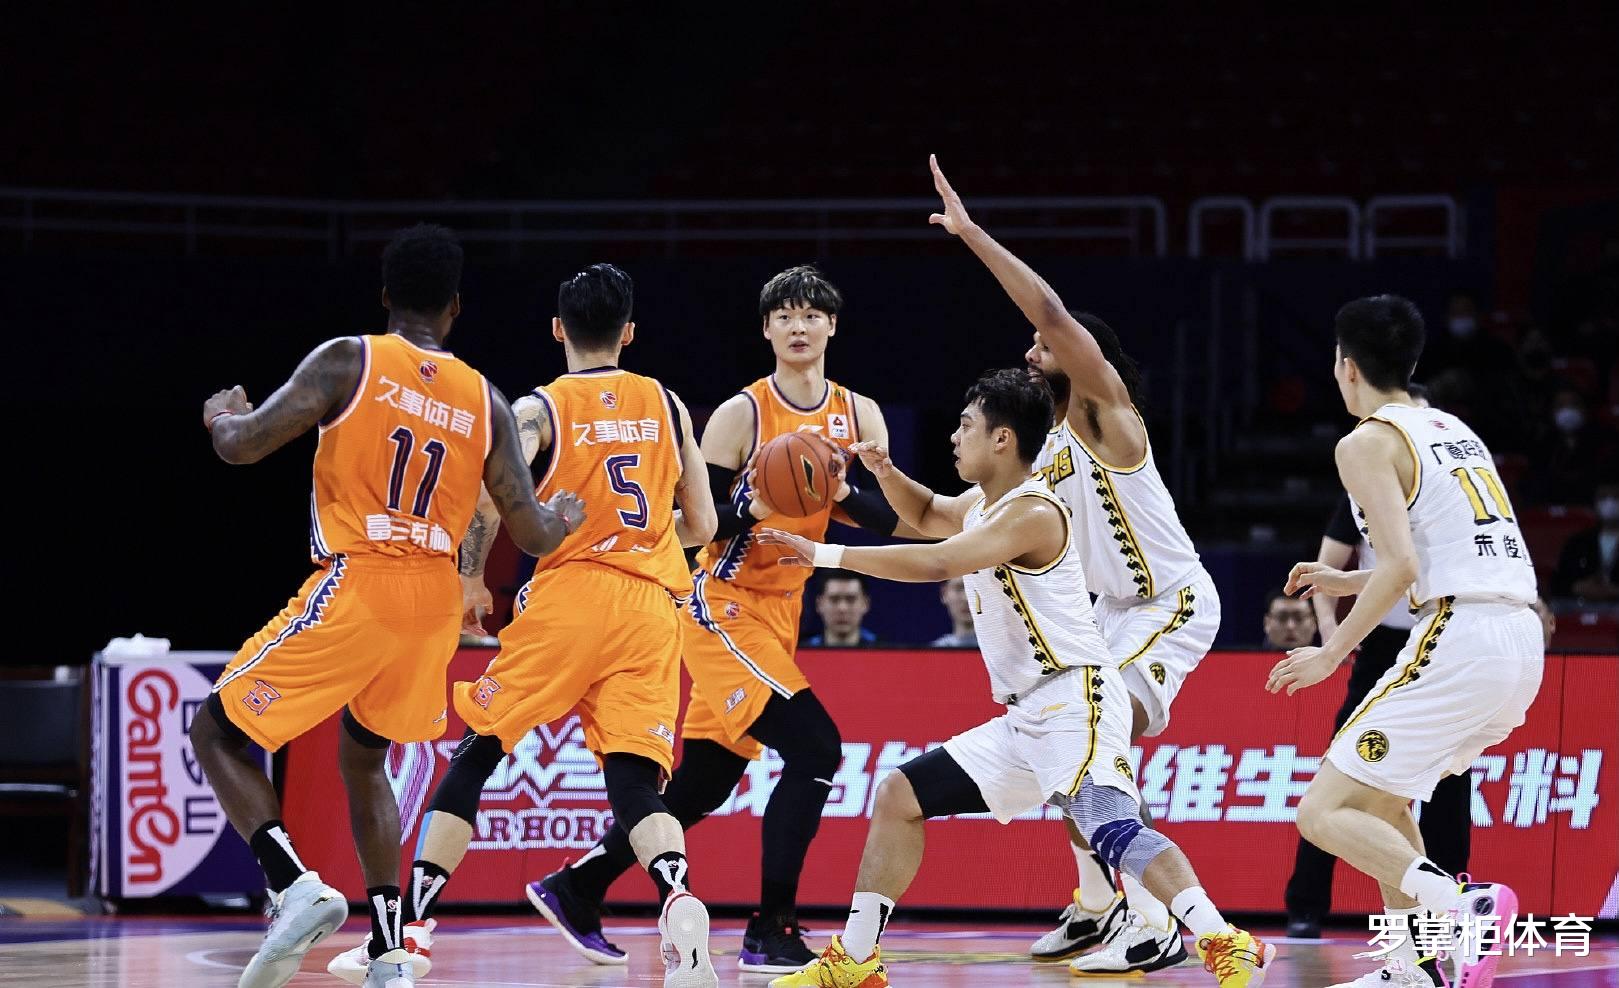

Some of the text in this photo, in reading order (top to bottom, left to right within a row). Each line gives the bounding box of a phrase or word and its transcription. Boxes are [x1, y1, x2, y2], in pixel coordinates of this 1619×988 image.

[374, 374, 476, 438] 久事体育
[572, 417, 660, 447] 久事体育
[387, 426, 448, 519] 11
[603, 453, 649, 531] 5
[1474, 533, 1533, 567] 朱俊
